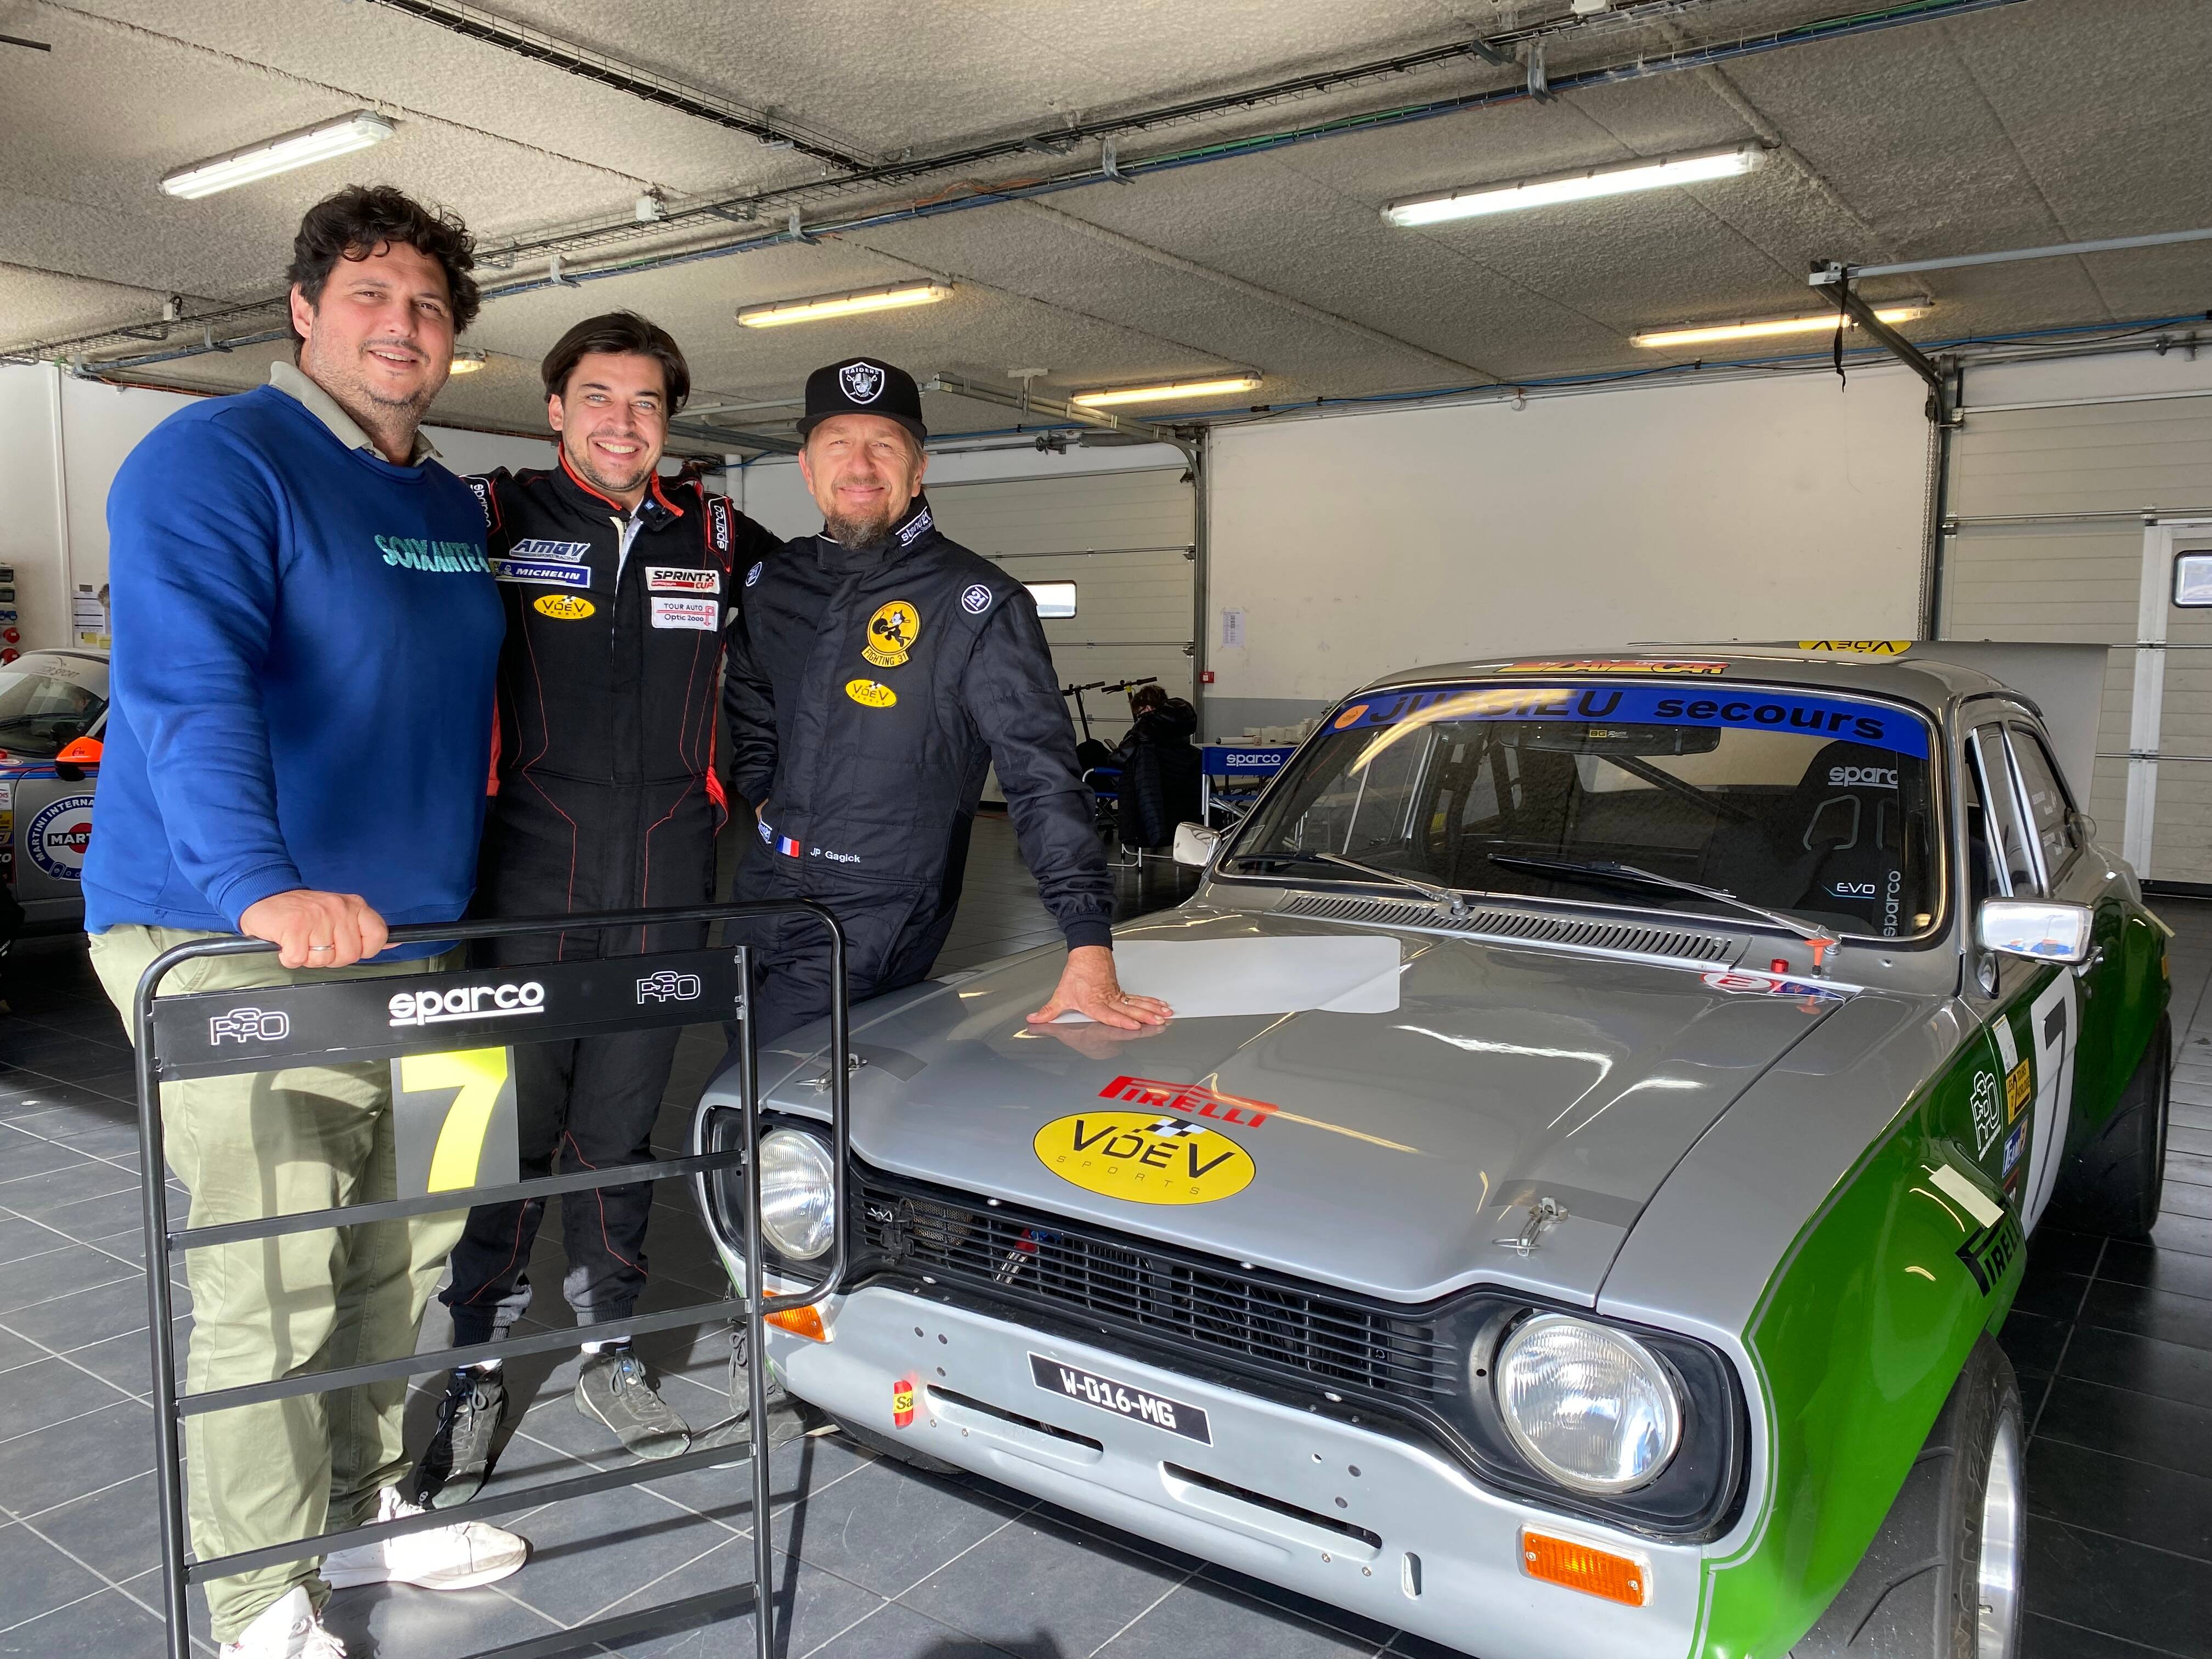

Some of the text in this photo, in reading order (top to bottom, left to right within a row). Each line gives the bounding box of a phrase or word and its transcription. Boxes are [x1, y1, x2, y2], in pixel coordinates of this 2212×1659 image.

[714, 505, 729, 551] sparco
[516, 568, 580, 580] MICHELIN
[543, 600, 586, 612] VDEV
[967, 591, 985, 607] 21
[864, 648, 907, 665] FIGHTING 31
[1653, 699, 1886, 740] secours
[1227, 754, 1280, 766] sparco
[1828, 767, 1898, 788] sparc
[32, 817, 48, 861] MARTINI
[810, 848, 860, 863] JP Gagick
[1837, 882, 1875, 894] EVO
[1883, 871, 1901, 936] sparco
[389, 981, 545, 1025] sparco
[401, 1046, 508, 1193] 7
[1098, 1076, 1280, 1128] PIRELLI
[1071, 1119, 1236, 1179] VDEV
[1056, 1155, 1200, 1195] SPORTS
[1060, 1368, 1176, 1429] W-016-MG
